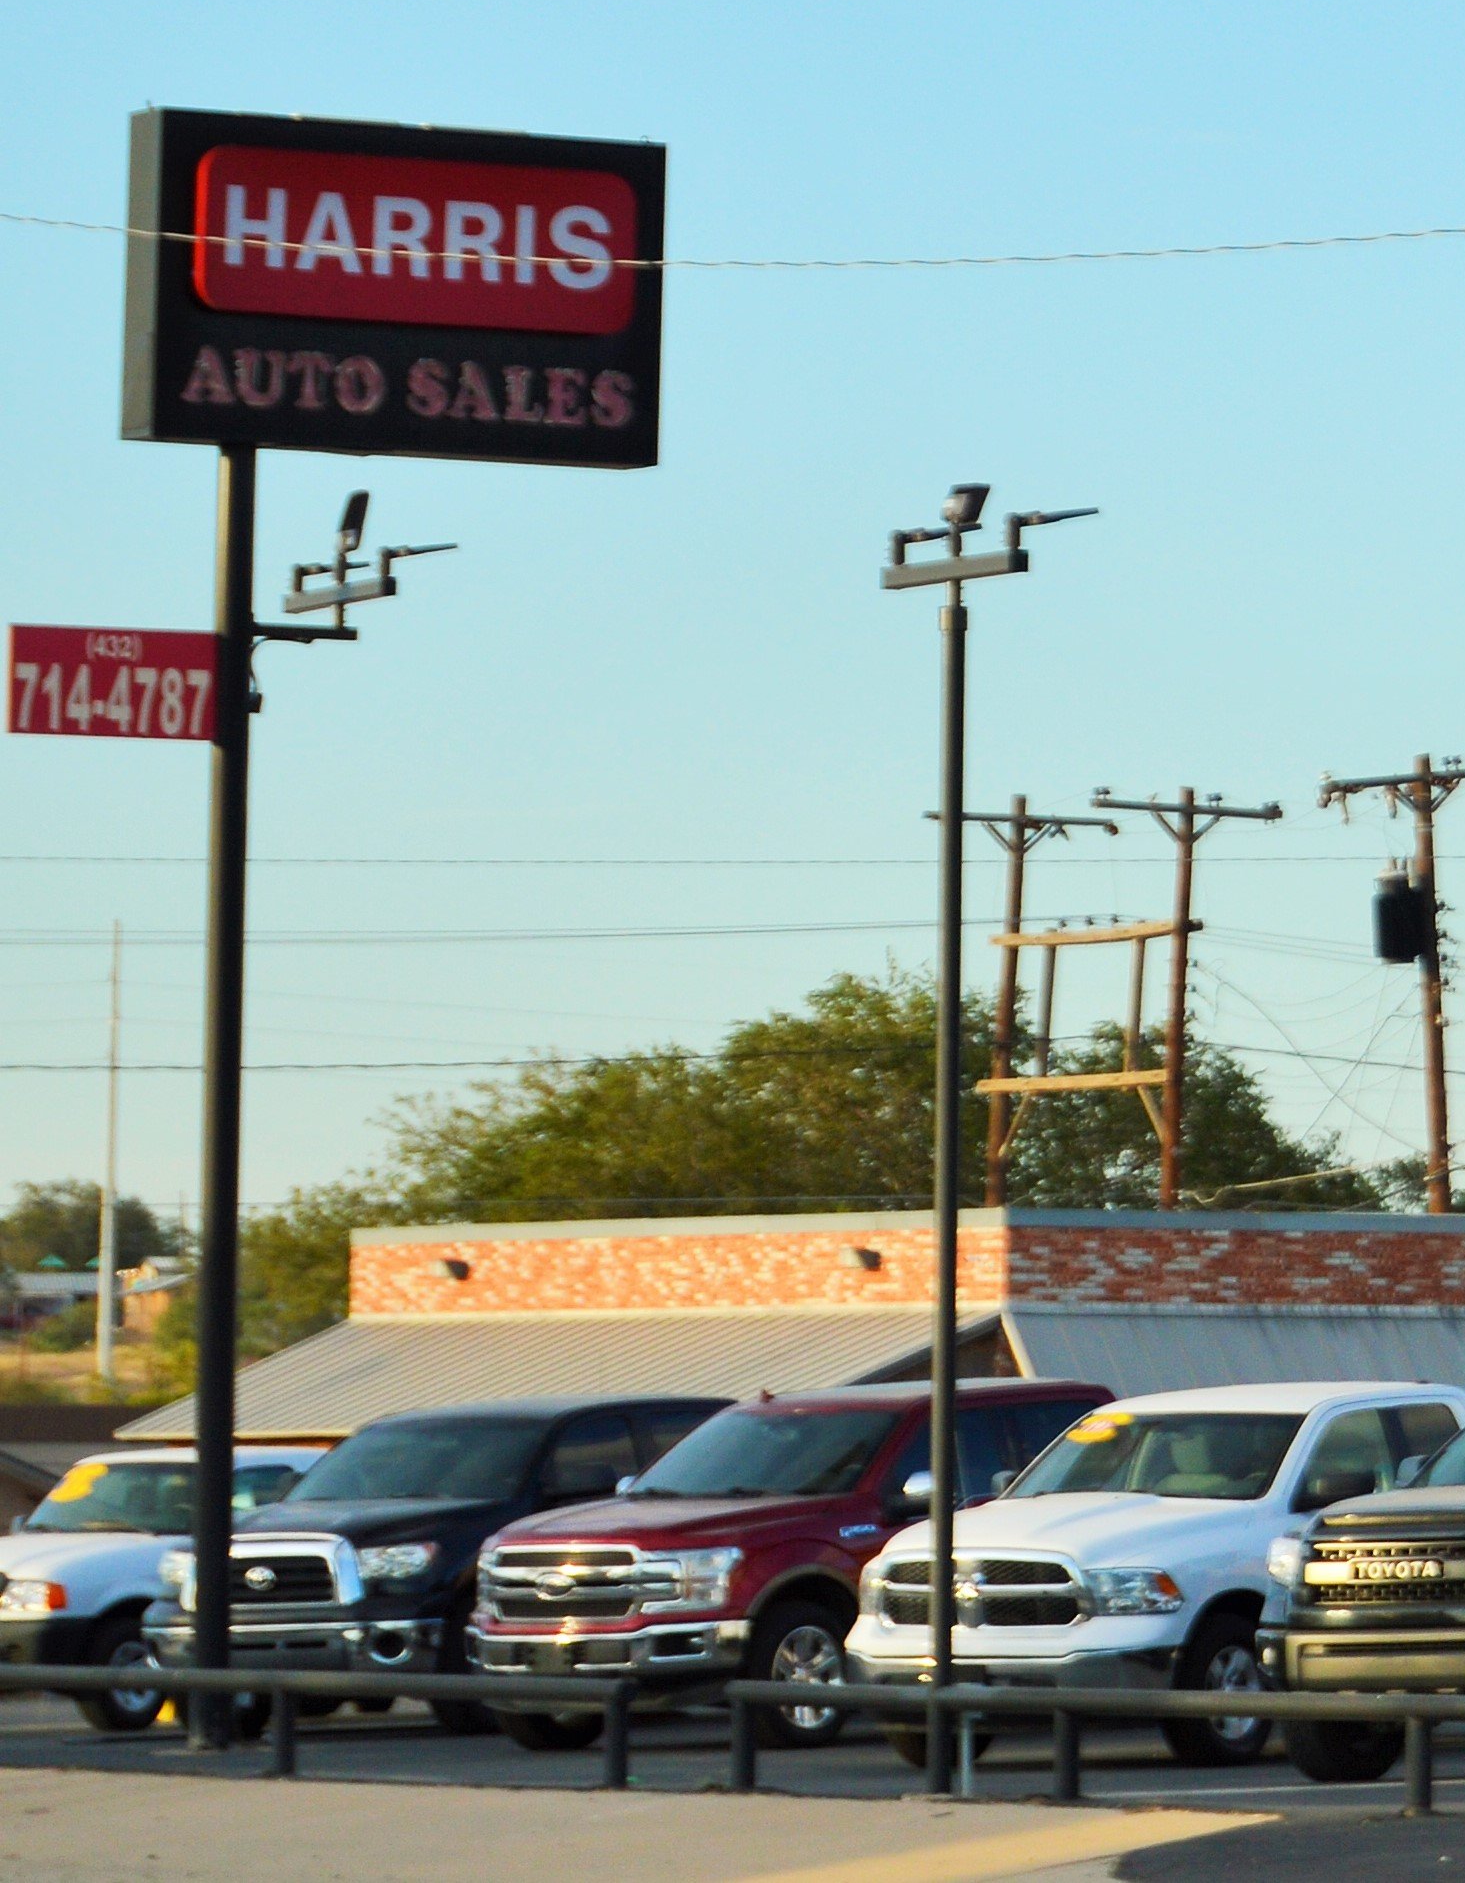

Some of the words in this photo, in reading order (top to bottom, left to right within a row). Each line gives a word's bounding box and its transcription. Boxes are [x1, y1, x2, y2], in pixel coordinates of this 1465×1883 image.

[223, 184, 613, 290] HARRIS
[179, 344, 386, 413] AUTO
[406, 356, 634, 428] SALES
[85, 631, 143, 662] (432)
[14, 661, 212, 736] 714-4787
[1354, 1560, 1441, 1579] TOYOTA
